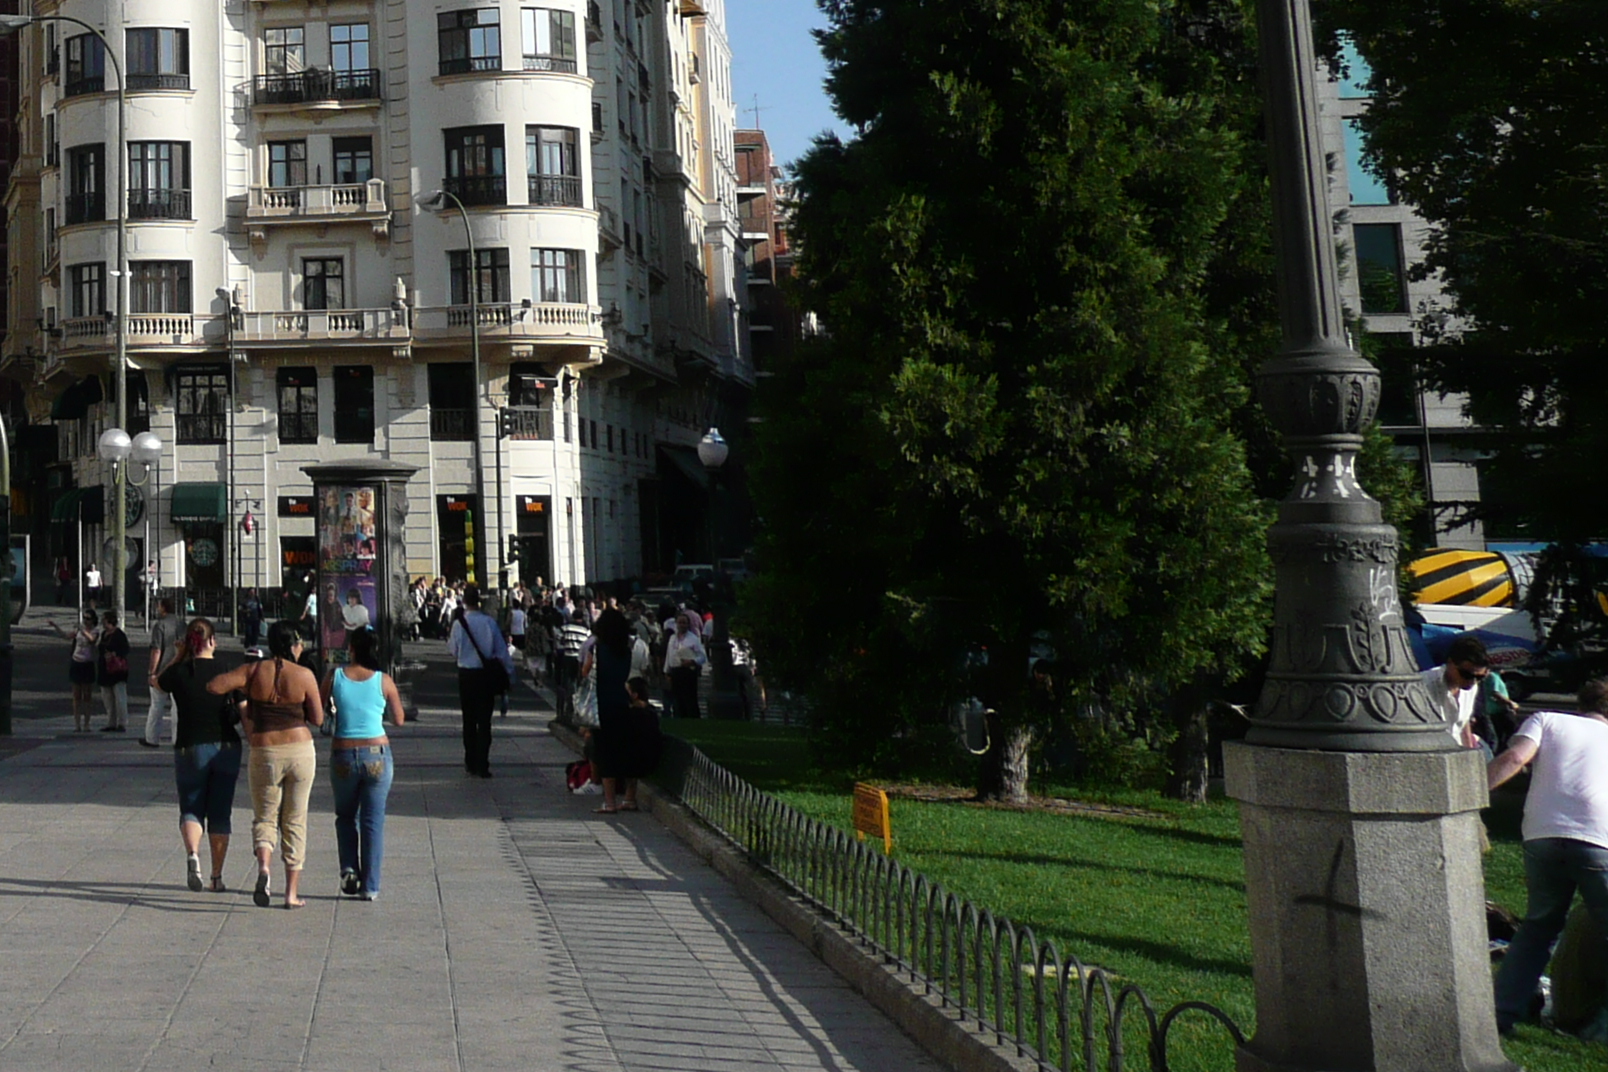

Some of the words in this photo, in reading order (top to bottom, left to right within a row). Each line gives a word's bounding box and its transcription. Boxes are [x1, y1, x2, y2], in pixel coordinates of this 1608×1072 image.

[289, 502, 310, 514] WOK
[447, 501, 468, 511] WOK
[525, 501, 545, 513] WOK
